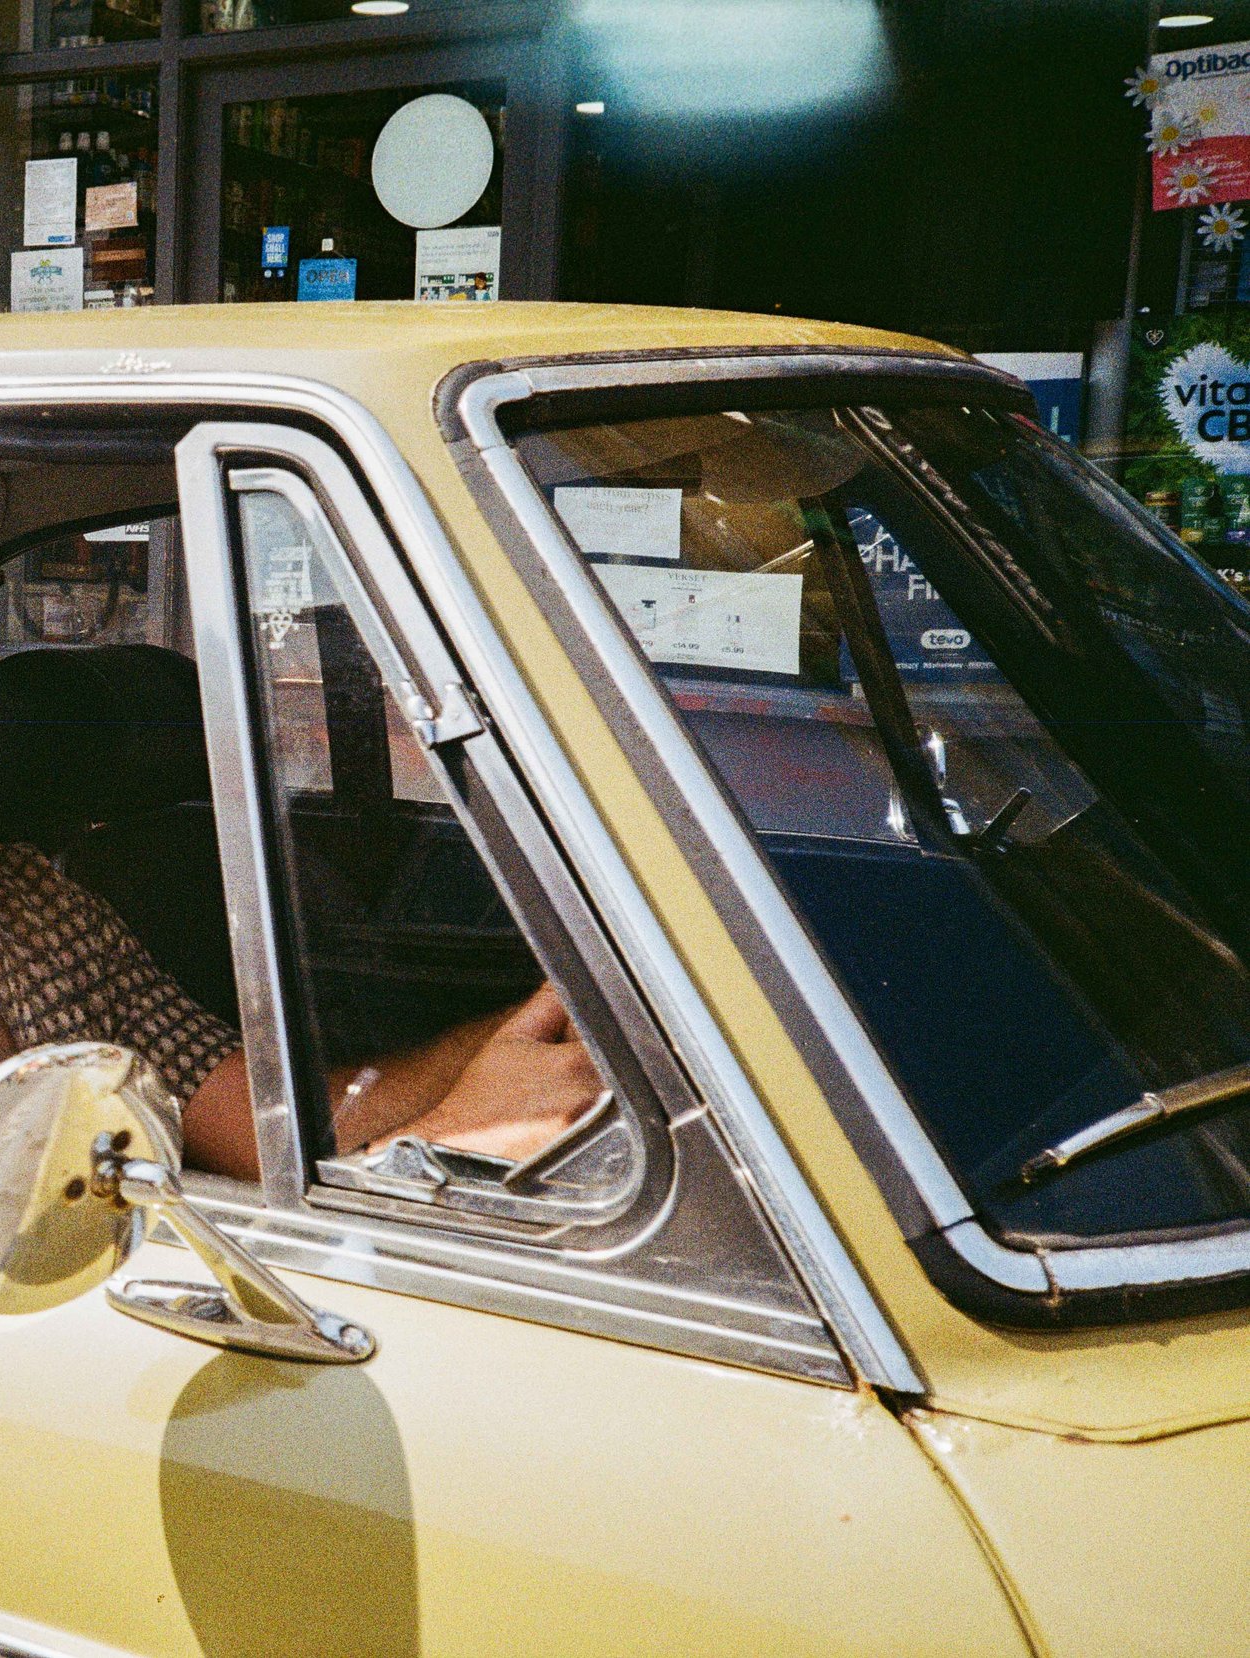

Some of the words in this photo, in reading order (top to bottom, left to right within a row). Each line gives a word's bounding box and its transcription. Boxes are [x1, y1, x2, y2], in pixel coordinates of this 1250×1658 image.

[306, 269, 350, 284] OPEN
[126, 524, 150, 533] NHS
[929, 632, 964, 645] teva
